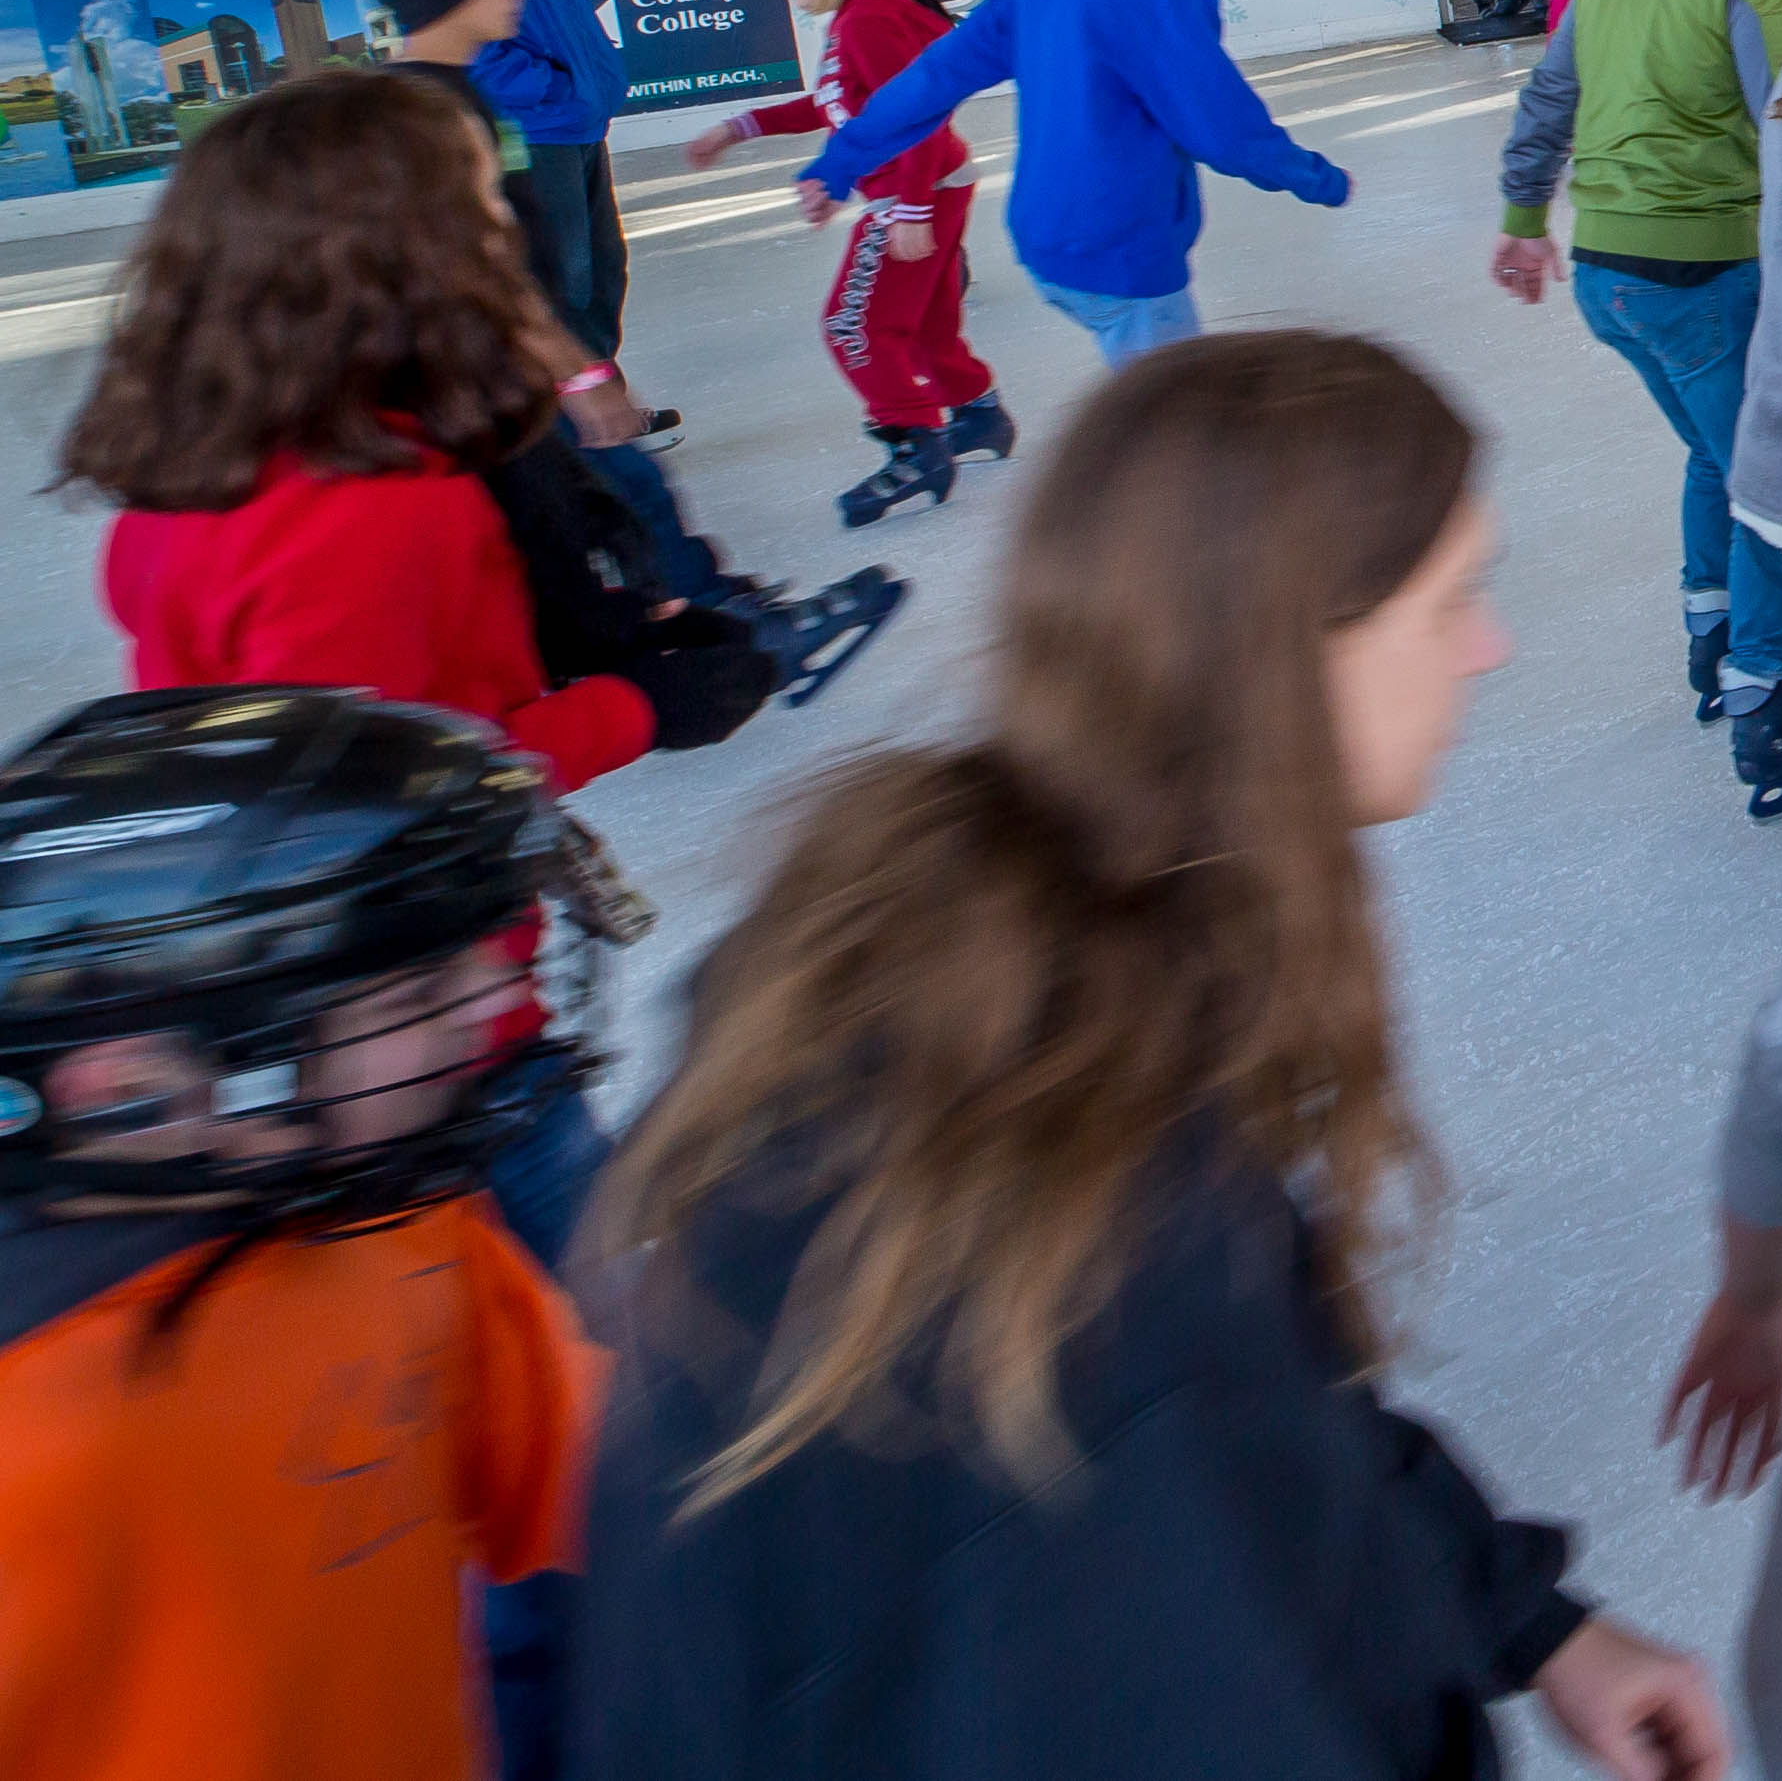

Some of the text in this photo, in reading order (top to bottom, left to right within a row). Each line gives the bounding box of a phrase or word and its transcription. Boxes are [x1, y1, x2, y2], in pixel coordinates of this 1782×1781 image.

[637, 8, 744, 34] College
[626, 69, 762, 98] WITHIN REACH.
